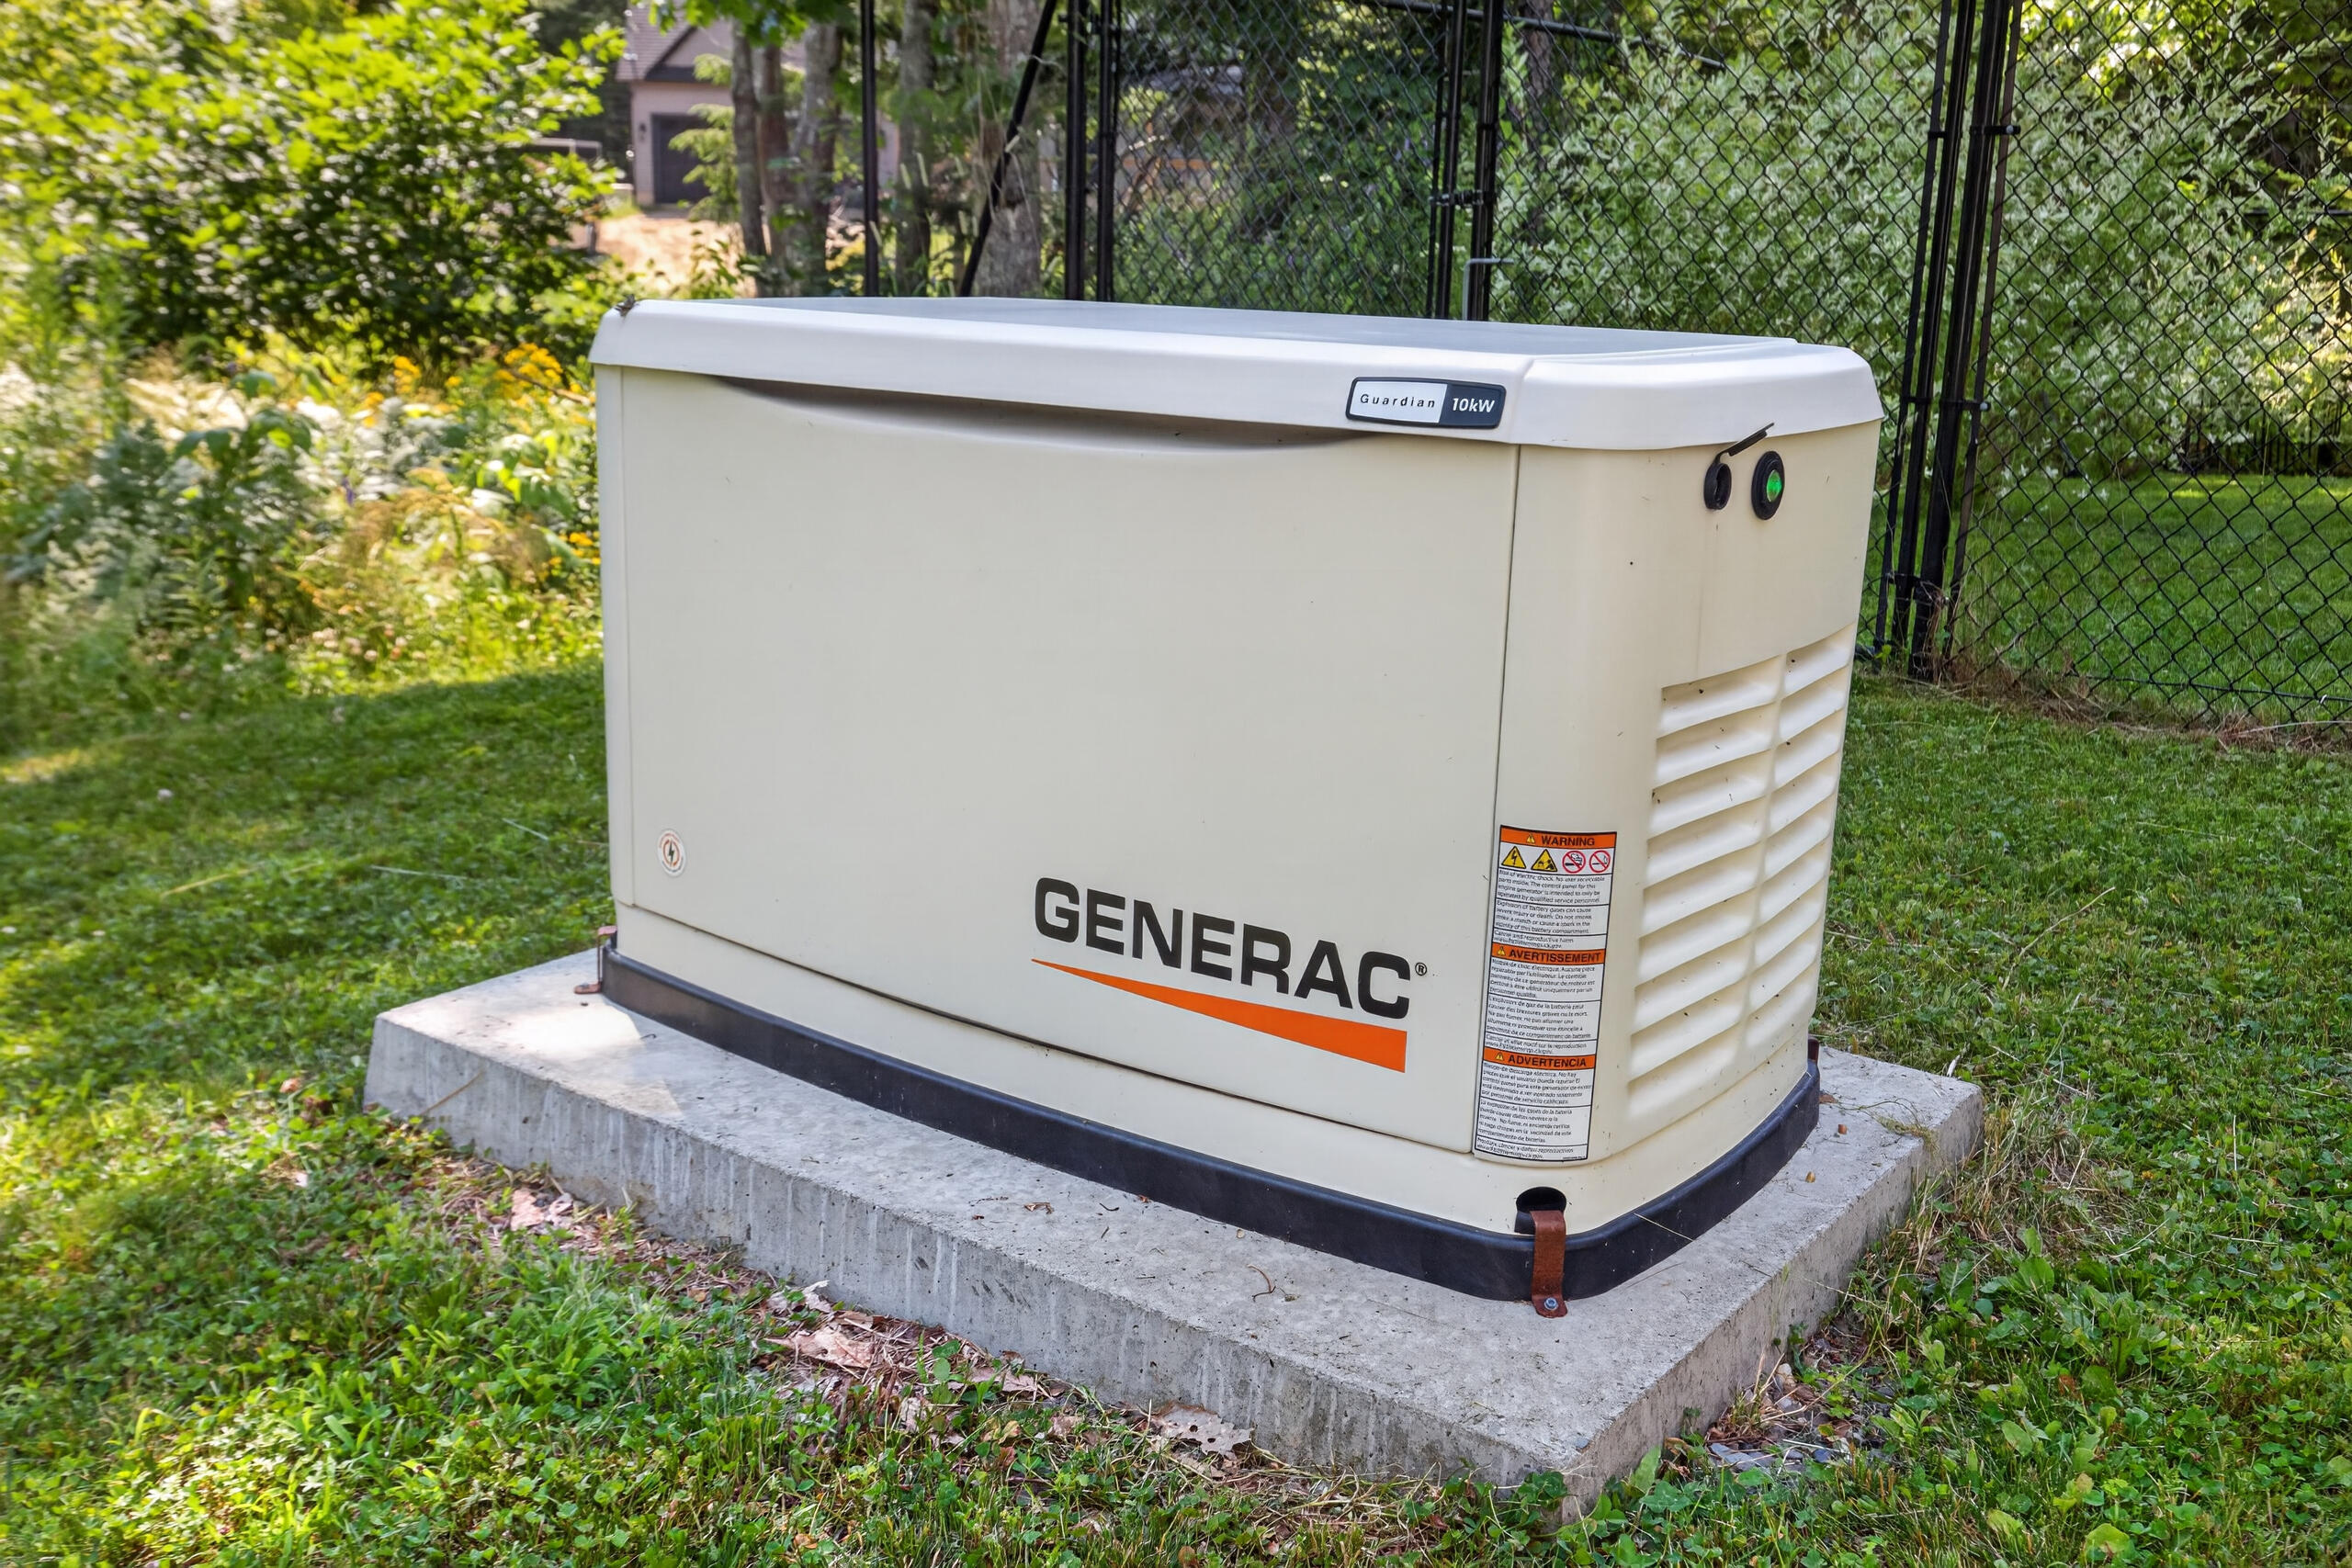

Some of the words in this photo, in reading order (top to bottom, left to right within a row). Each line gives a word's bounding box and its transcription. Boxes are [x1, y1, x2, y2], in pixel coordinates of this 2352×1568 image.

[1360, 393, 1436, 408] Guardian
[1453, 397, 1496, 412] 10kW
[1542, 835, 1595, 847] WARNING
[1509, 949, 1601, 963] AVERTISSEMENT
[1508, 1055, 1587, 1067] ADVERTENCIA
